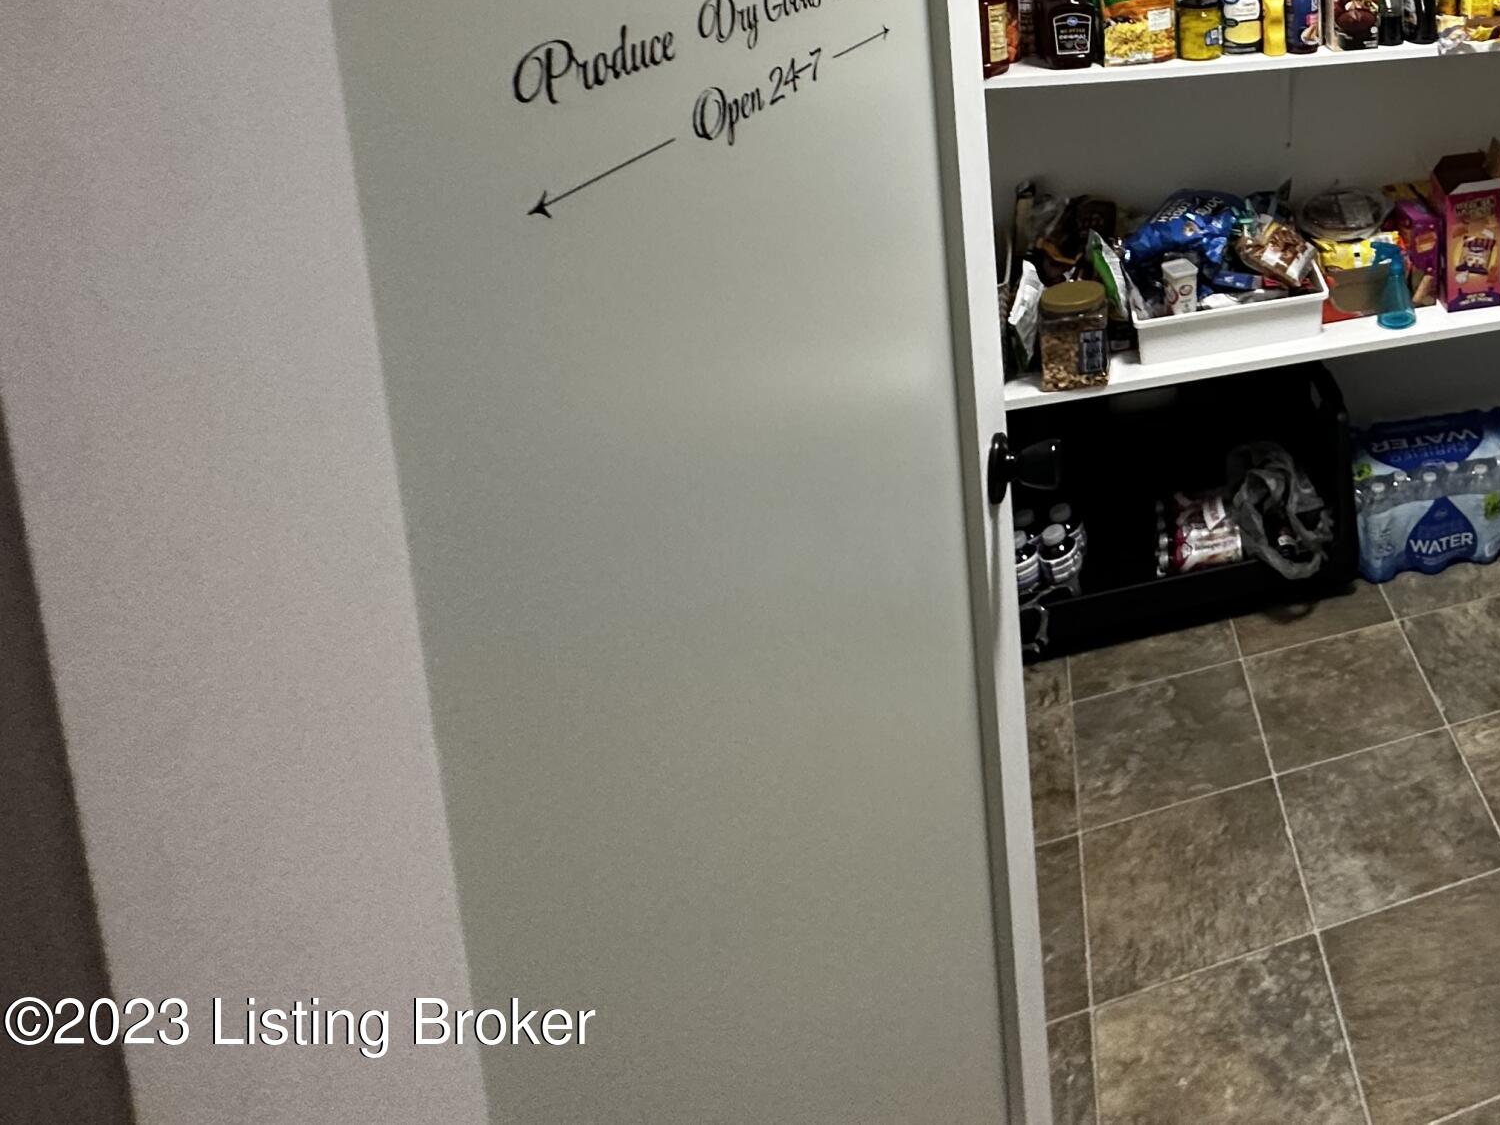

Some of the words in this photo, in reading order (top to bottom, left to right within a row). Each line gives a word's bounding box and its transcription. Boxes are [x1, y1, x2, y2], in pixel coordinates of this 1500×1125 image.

[512, 24, 676, 105] Produce
[692, 86, 765, 146] Open
[769, 47, 822, 106] 24-7
[1372, 428, 1479, 453] WATER
[1409, 532, 1474, 555] WATER
